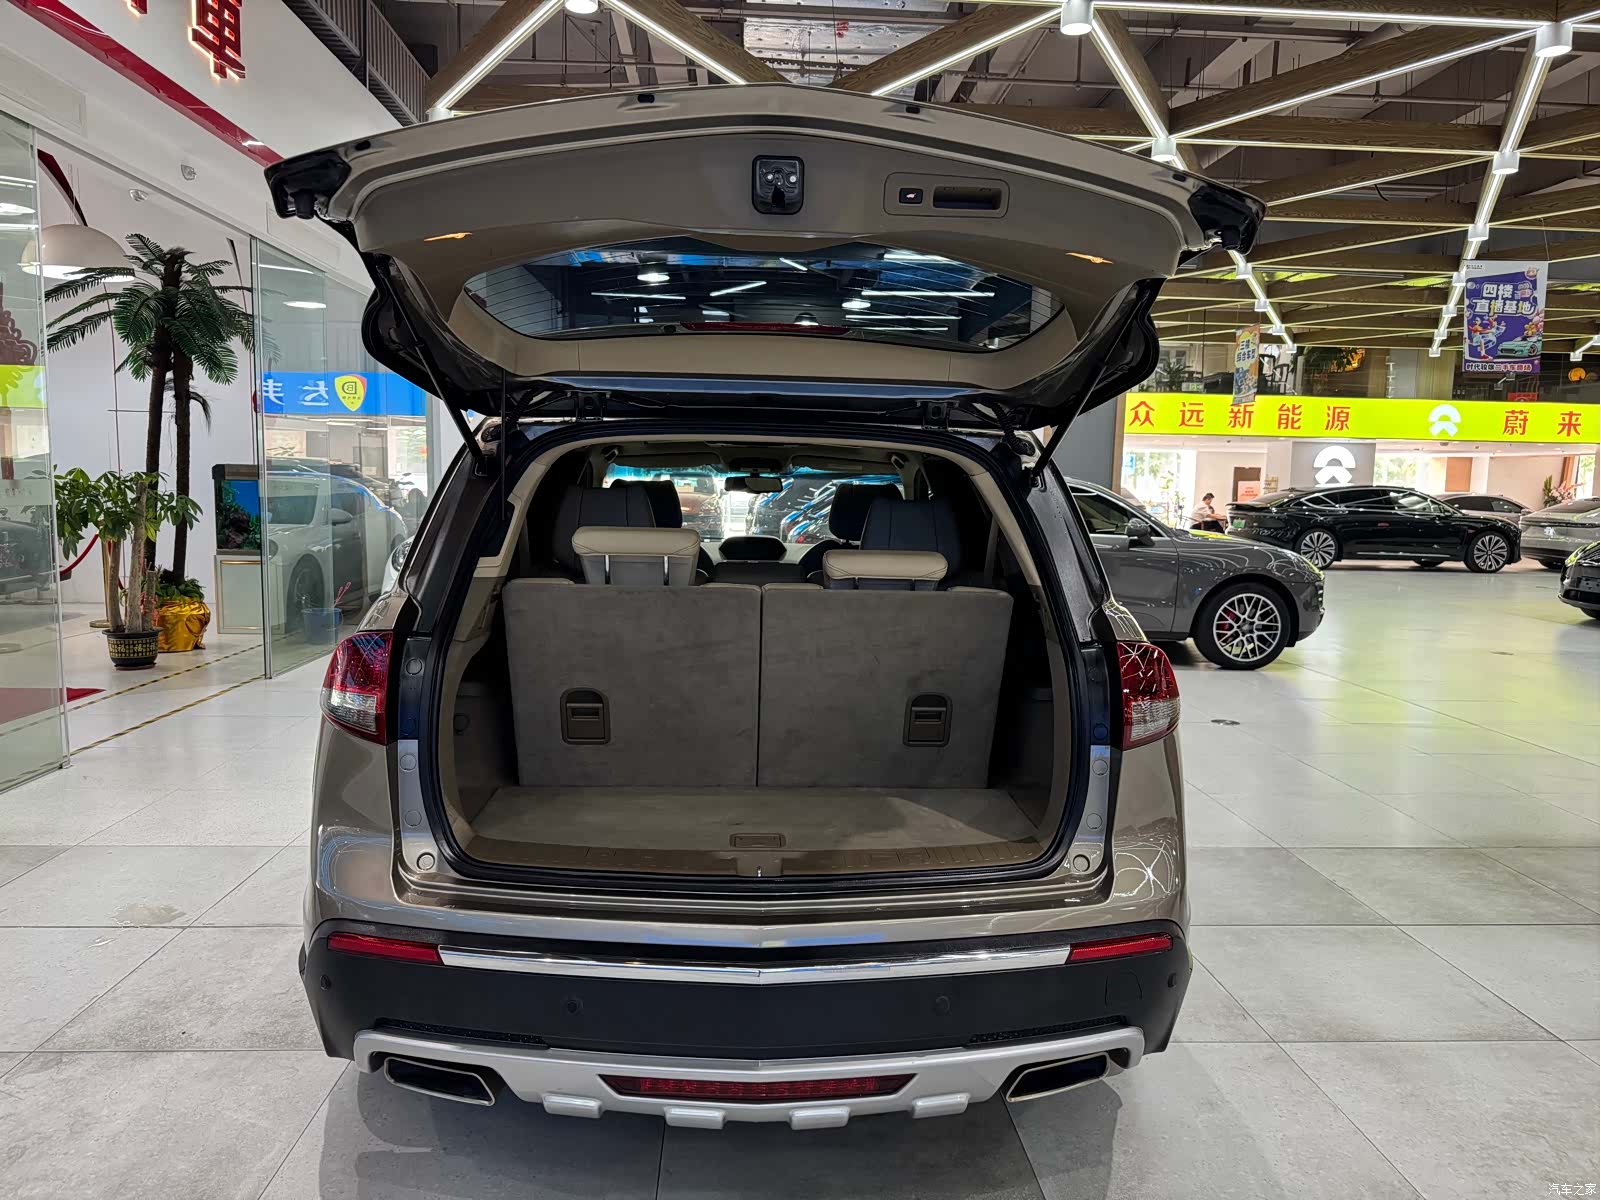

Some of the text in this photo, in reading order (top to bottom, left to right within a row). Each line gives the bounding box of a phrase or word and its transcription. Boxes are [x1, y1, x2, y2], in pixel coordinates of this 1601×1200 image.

[1483, 284, 1513, 299] 四楼
[1473, 299, 1535, 316] 直播基地
[1129, 400, 1582, 437] 众远新能源 蔚来
